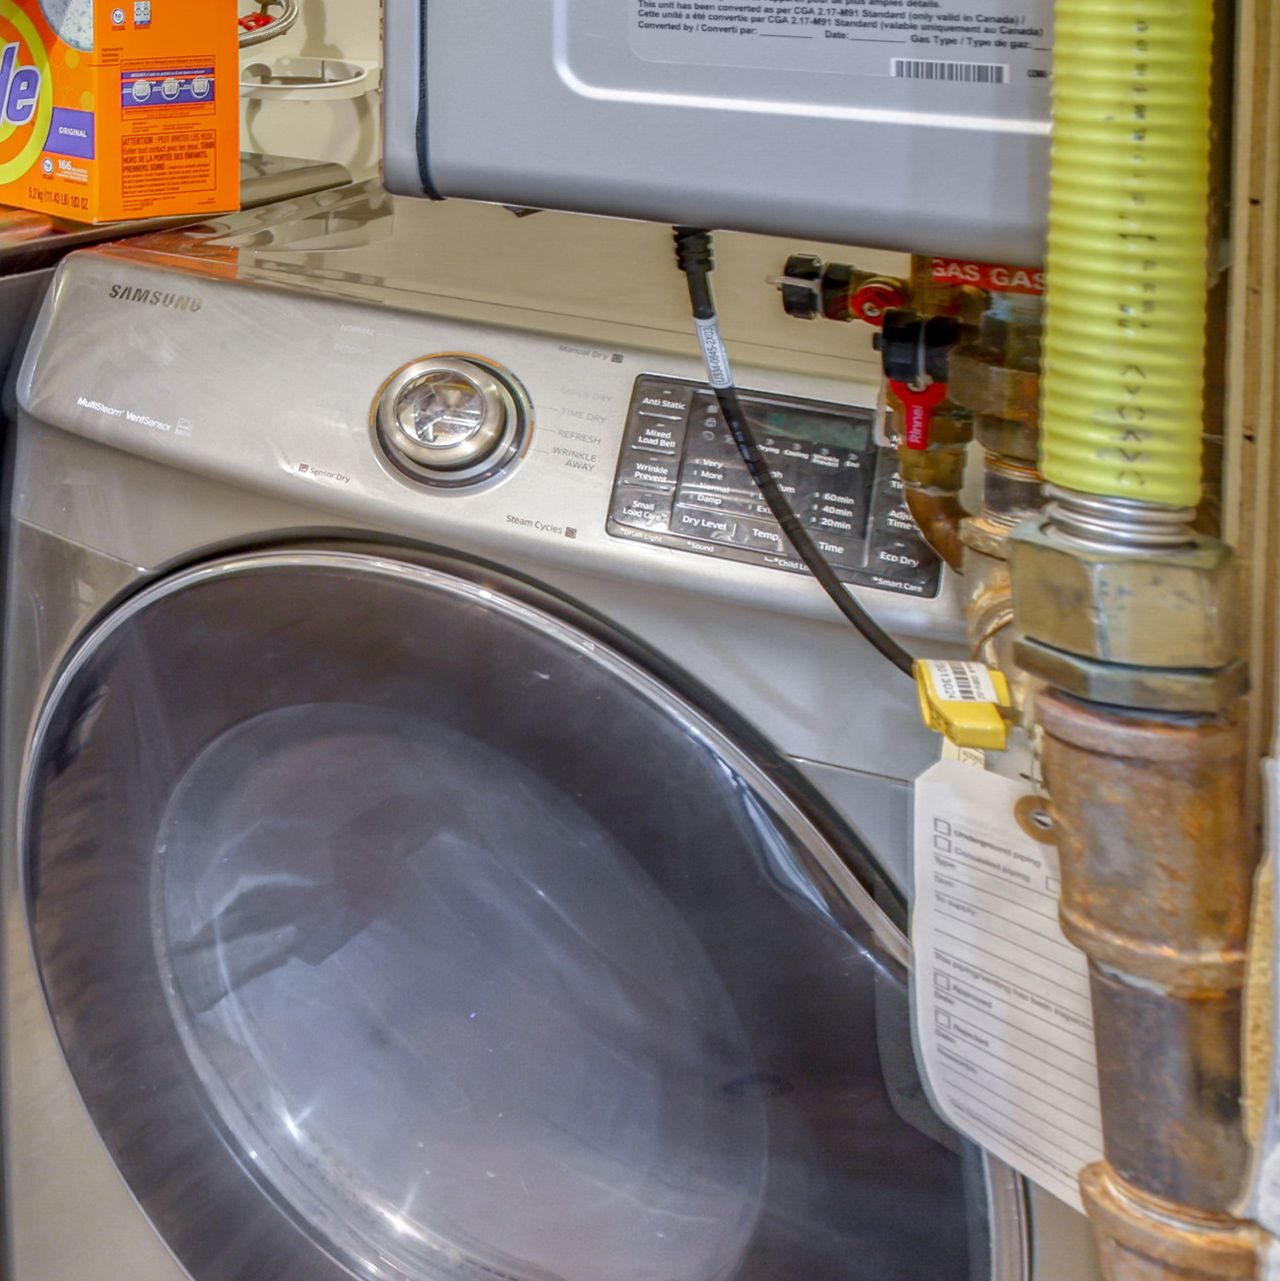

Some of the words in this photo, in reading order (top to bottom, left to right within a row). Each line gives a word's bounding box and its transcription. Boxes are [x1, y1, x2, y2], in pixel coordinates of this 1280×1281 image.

[58, 127, 87, 137] ORIGINAL
[58, 159, 72, 169] 166
[931, 258, 981, 282] GAS
[991, 269, 1047, 290] GAS
[109, 284, 204, 312] SAMSUNG
[558, 344, 589, 356] Manual
[591, 350, 609, 361] Dry
[643, 397, 659, 408] Anti
[661, 399, 686, 410] Static
[126, 411, 172, 432] VentSensor
[560, 408, 583, 418] TIME
[586, 412, 607, 423] DRY
[910, 405, 925, 445] Rinnai
[557, 430, 602, 445] REFRESH
[645, 429, 671, 439] Mixed
[638, 436, 658, 446] Load
[659, 439, 676, 448] Bell
[552, 447, 597, 462] WRINKLE
[564, 459, 596, 471] AWAY
[636, 463, 668, 475] Wrinkle
[703, 458, 723, 469] Very
[310, 467, 334, 479] Sensor
[334, 473, 350, 483] Dry
[635, 471, 667, 483] Prevent
[701, 471, 723, 480] More
[699, 483, 730, 494] Normal
[632, 499, 654, 510] Small
[697, 495, 722, 506] Damp
[823, 493, 855, 505] 60min
[623, 508, 643, 518] Load
[822, 505, 853, 517] 40min
[505, 514, 533, 528] Steam
[534, 520, 563, 535] Cycles
[683, 515, 699, 528] Dry
[701, 518, 727, 531] Level
[821, 518, 852, 530] 20min
[818, 541, 844, 554] Time
[880, 552, 897, 562] Eco
[899, 554, 919, 568] Dry
